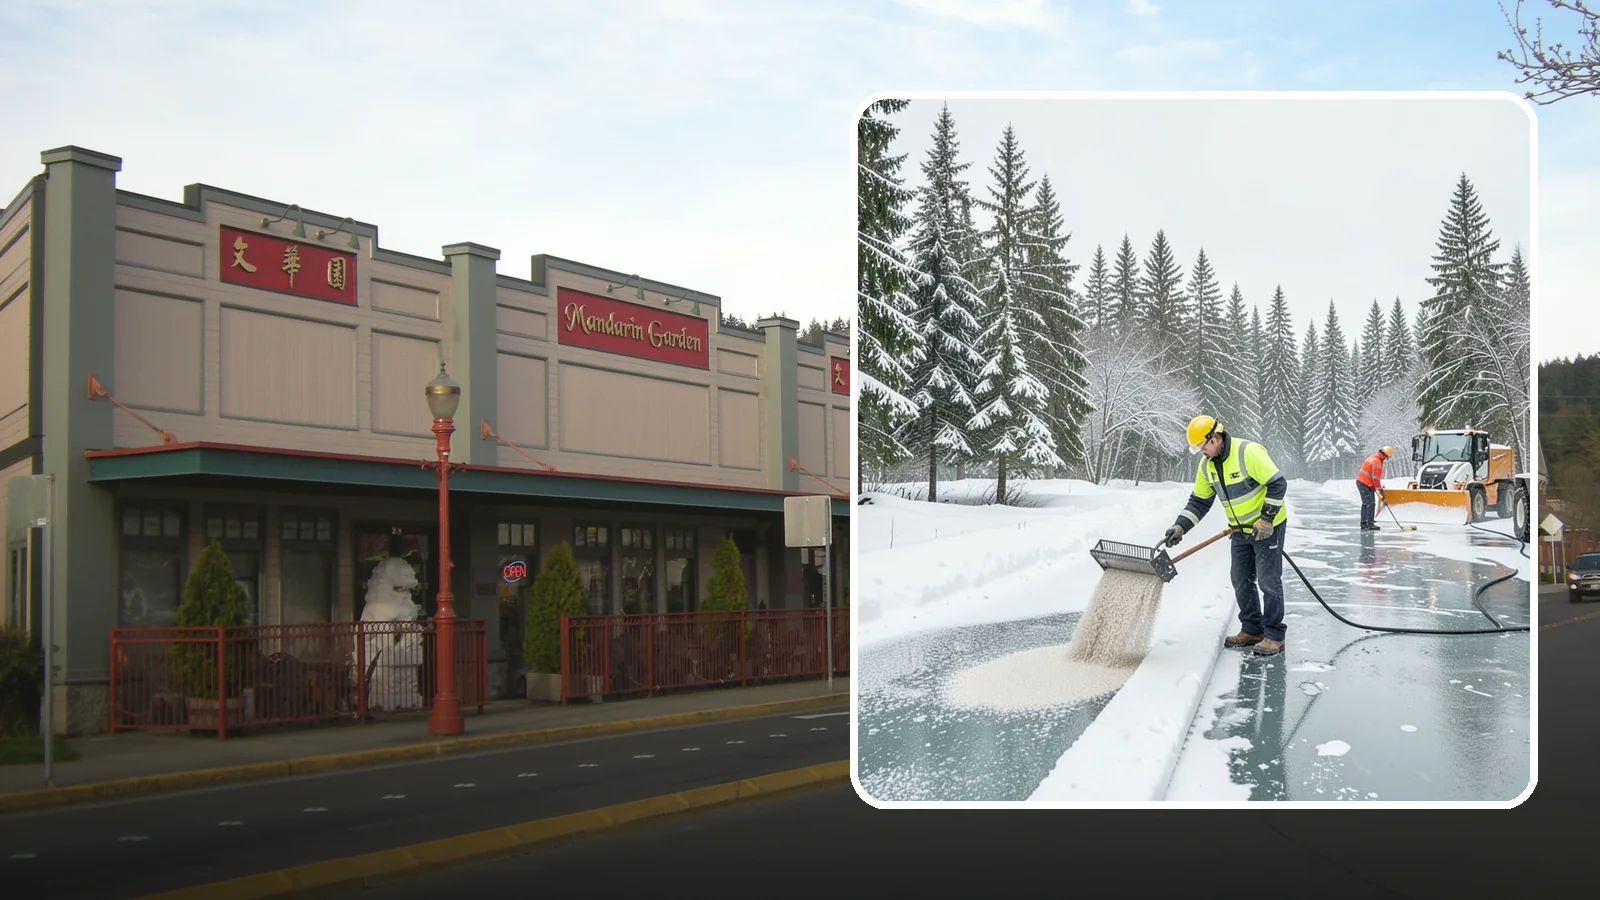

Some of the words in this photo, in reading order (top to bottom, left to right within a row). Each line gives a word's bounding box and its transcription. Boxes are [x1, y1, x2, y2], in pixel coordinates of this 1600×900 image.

[231, 236, 346, 290] 文華園
[564, 302, 644, 341] Mandarin
[647, 320, 702, 352] Garden
[835, 363, 846, 386] 文
[503, 565, 527, 578] OPEN
